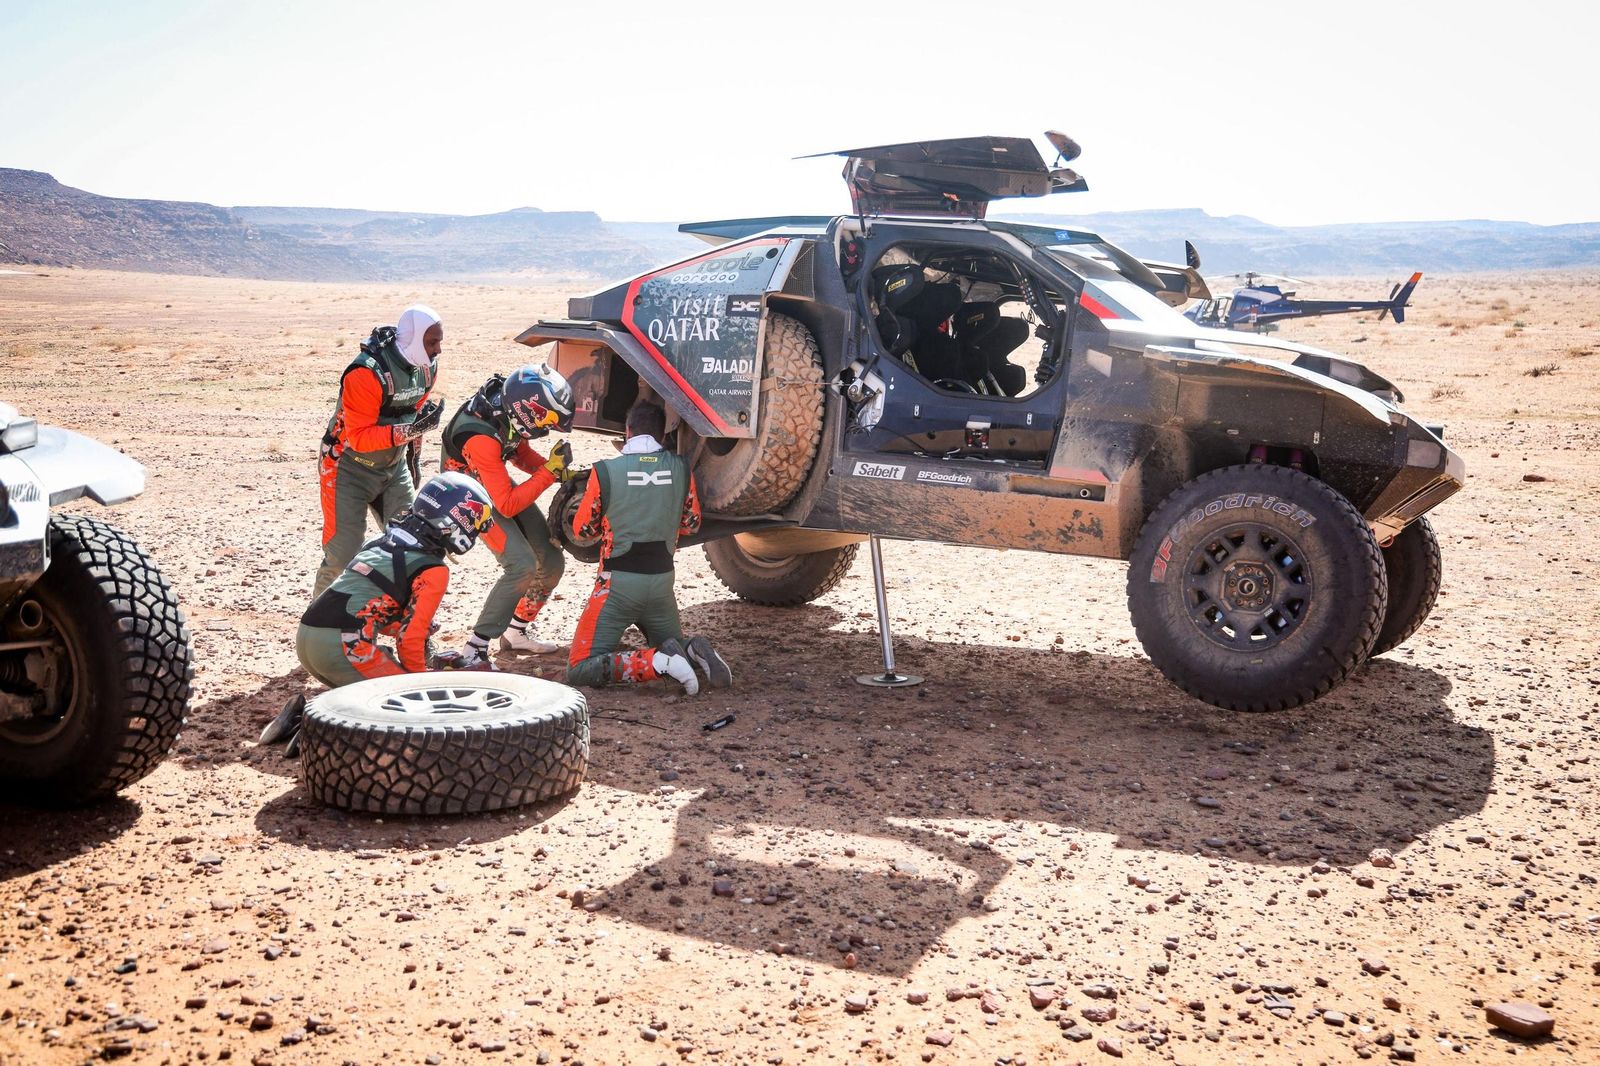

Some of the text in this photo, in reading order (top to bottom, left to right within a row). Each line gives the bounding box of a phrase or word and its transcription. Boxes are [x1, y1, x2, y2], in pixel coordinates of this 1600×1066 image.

[672, 272, 738, 284] ooredoo
[648, 318, 720, 347] QATAR
[859, 463, 900, 478] Sabelt
[917, 471, 972, 483] BFGoodrich
